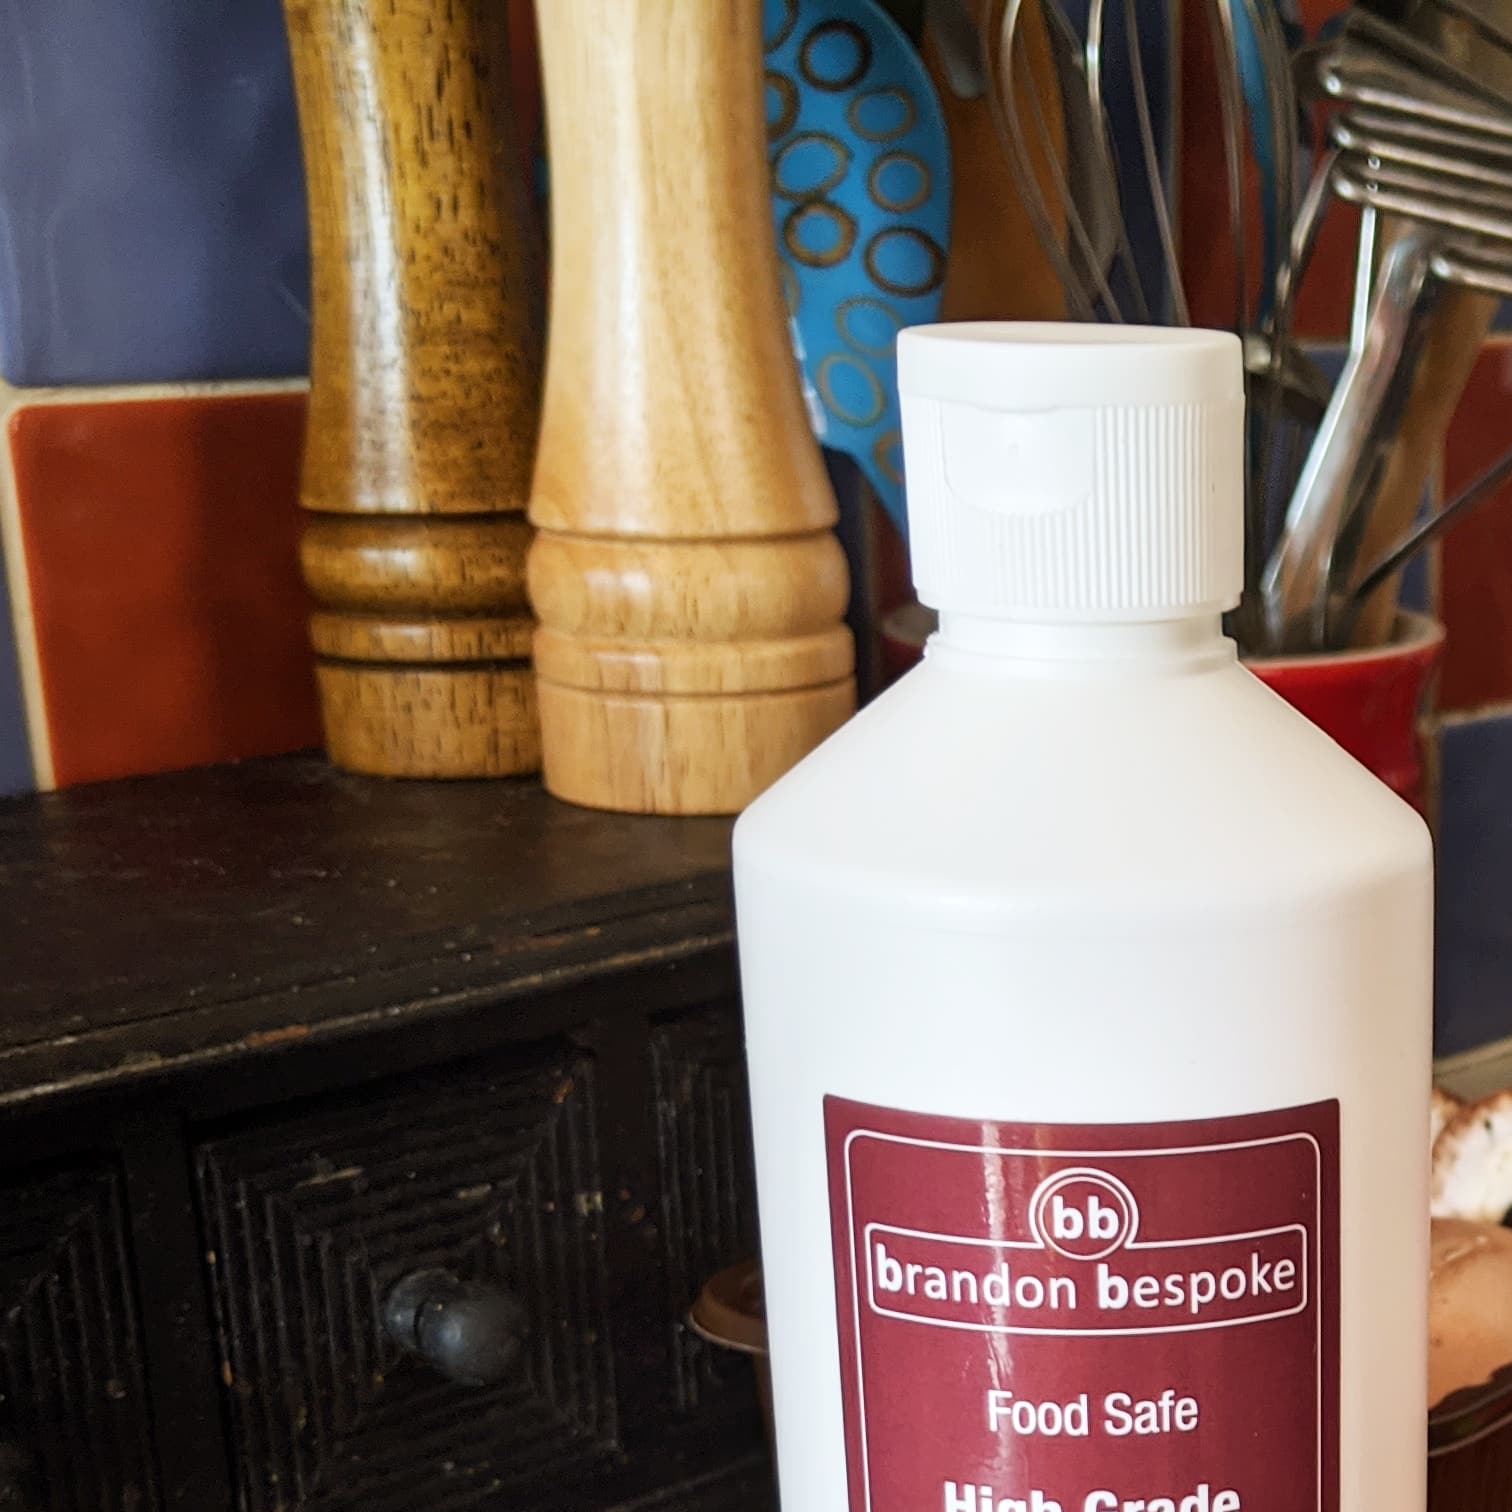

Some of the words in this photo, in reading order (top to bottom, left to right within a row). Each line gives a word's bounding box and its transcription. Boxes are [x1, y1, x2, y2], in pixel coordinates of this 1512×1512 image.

[1051, 1196, 1120, 1239] bb
[875, 1243, 1076, 1310] brandon
[1096, 1252, 1296, 1313] bespoke
[988, 1390, 1088, 1439] Food
[1104, 1390, 1197, 1435] Safe
